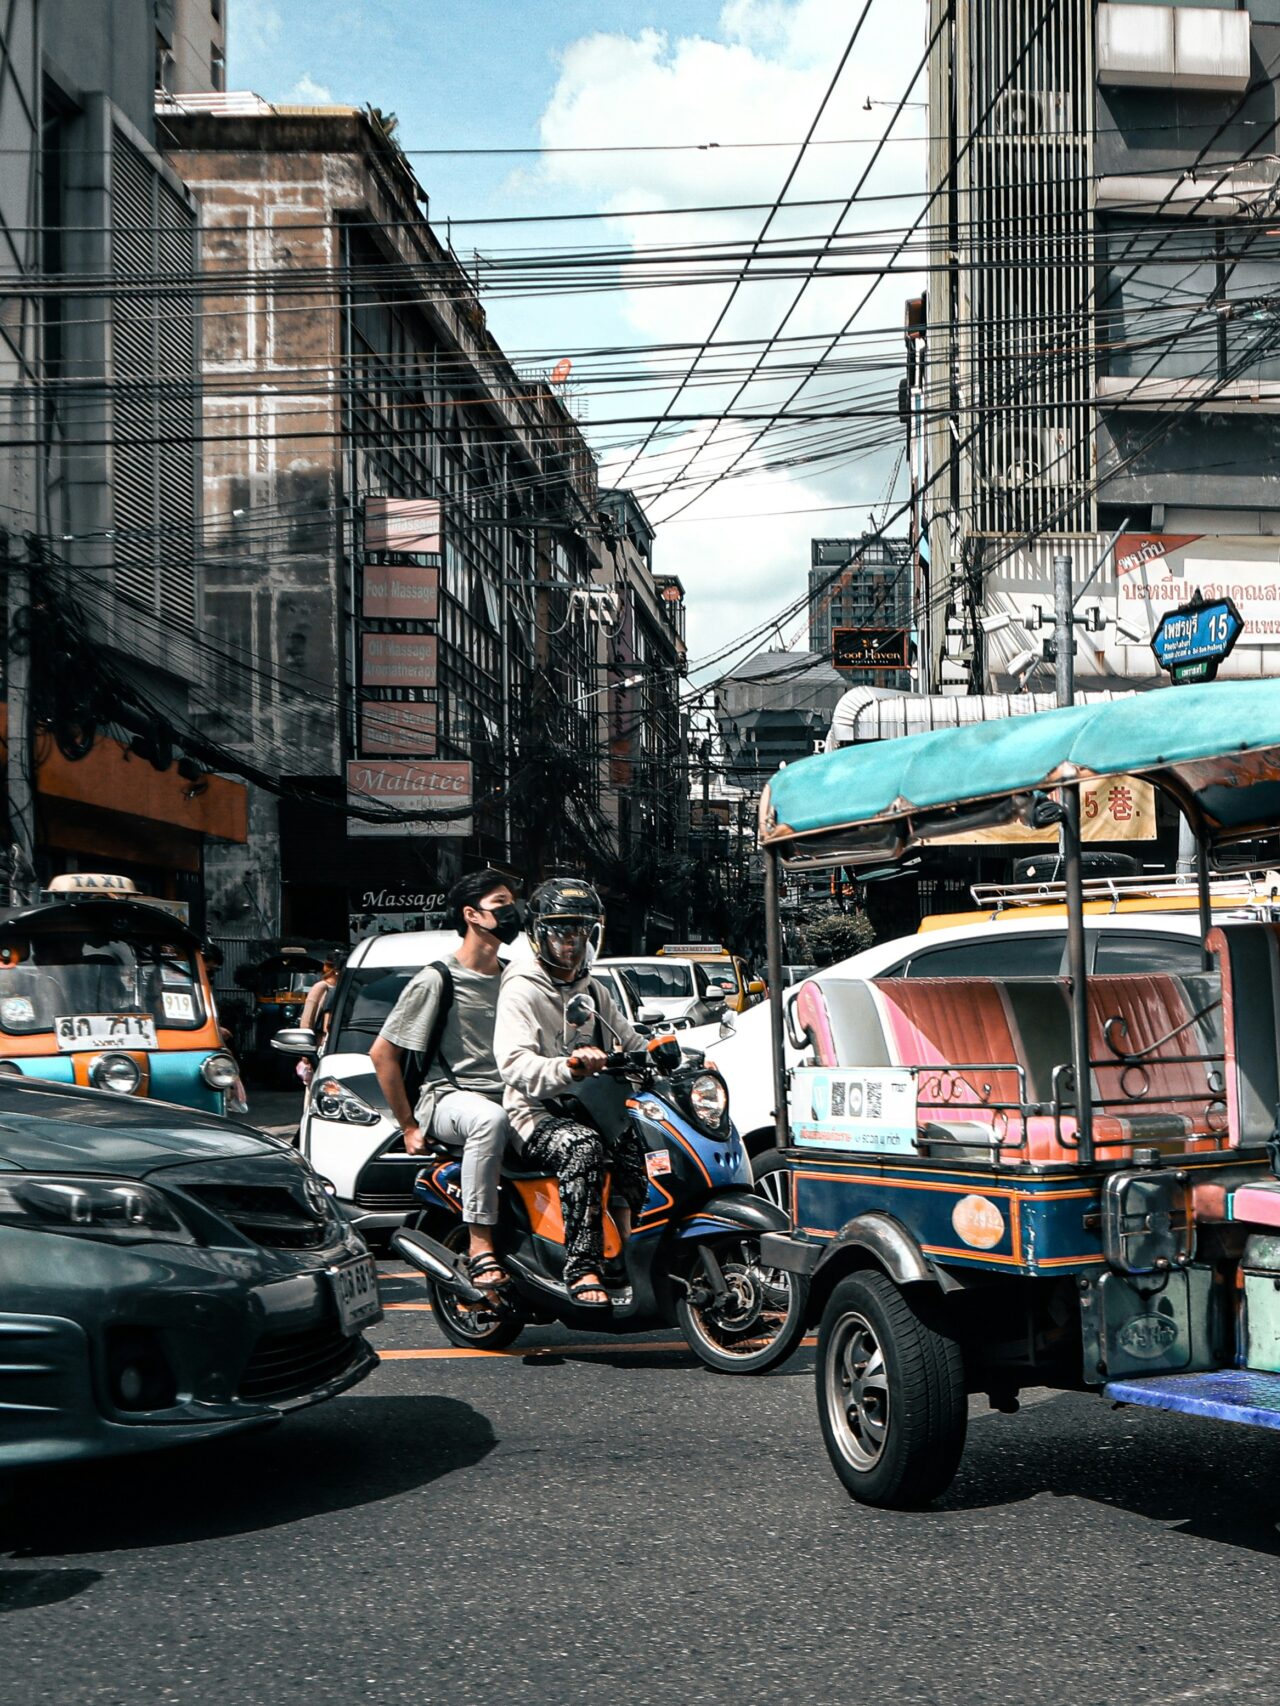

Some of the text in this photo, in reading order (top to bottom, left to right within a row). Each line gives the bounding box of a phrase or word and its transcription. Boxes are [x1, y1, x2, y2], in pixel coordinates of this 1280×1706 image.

[1118, 541, 1166, 570] พบกัน
[391, 581, 437, 603] Massage
[1164, 613, 1228, 642] เพชรบุรี 15
[386, 641, 433, 660] Massage
[839, 648, 900, 660] oot Haven
[363, 661, 437, 680] Aromatherapy
[355, 767, 465, 791] Malatee
[72, 876, 126, 889] TAXI
[362, 889, 445, 911] Massage
